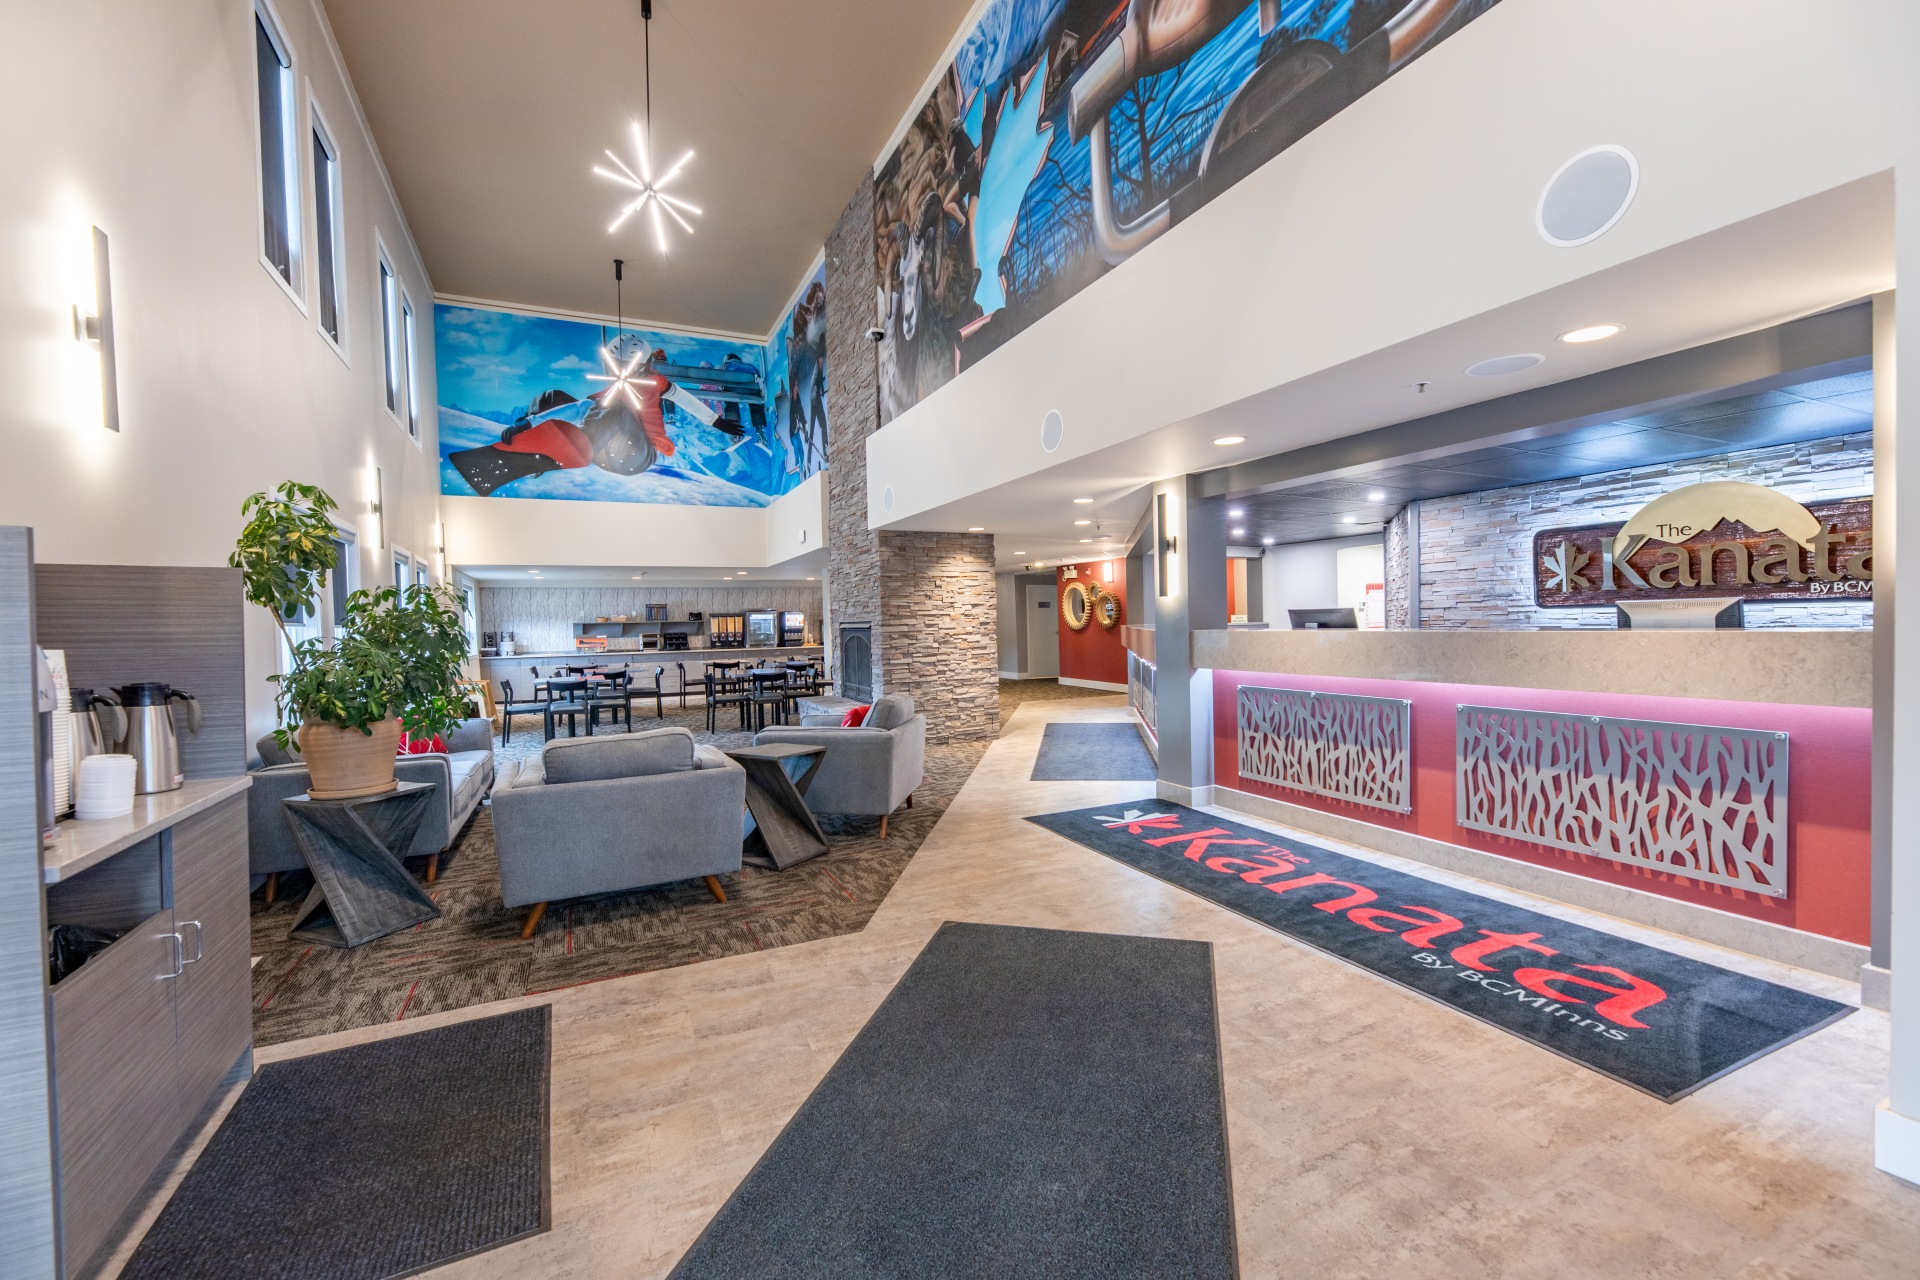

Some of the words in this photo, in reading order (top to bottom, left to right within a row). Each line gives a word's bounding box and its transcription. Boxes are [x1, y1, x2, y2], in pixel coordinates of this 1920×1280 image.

[1656, 523, 1692, 537] The
[1810, 582, 1830, 595] By
[1261, 845, 1310, 864] The
[1143, 827, 1668, 1026] Kanata
[1411, 952, 1454, 969] By
[1457, 969, 1629, 1041] BCMInns
